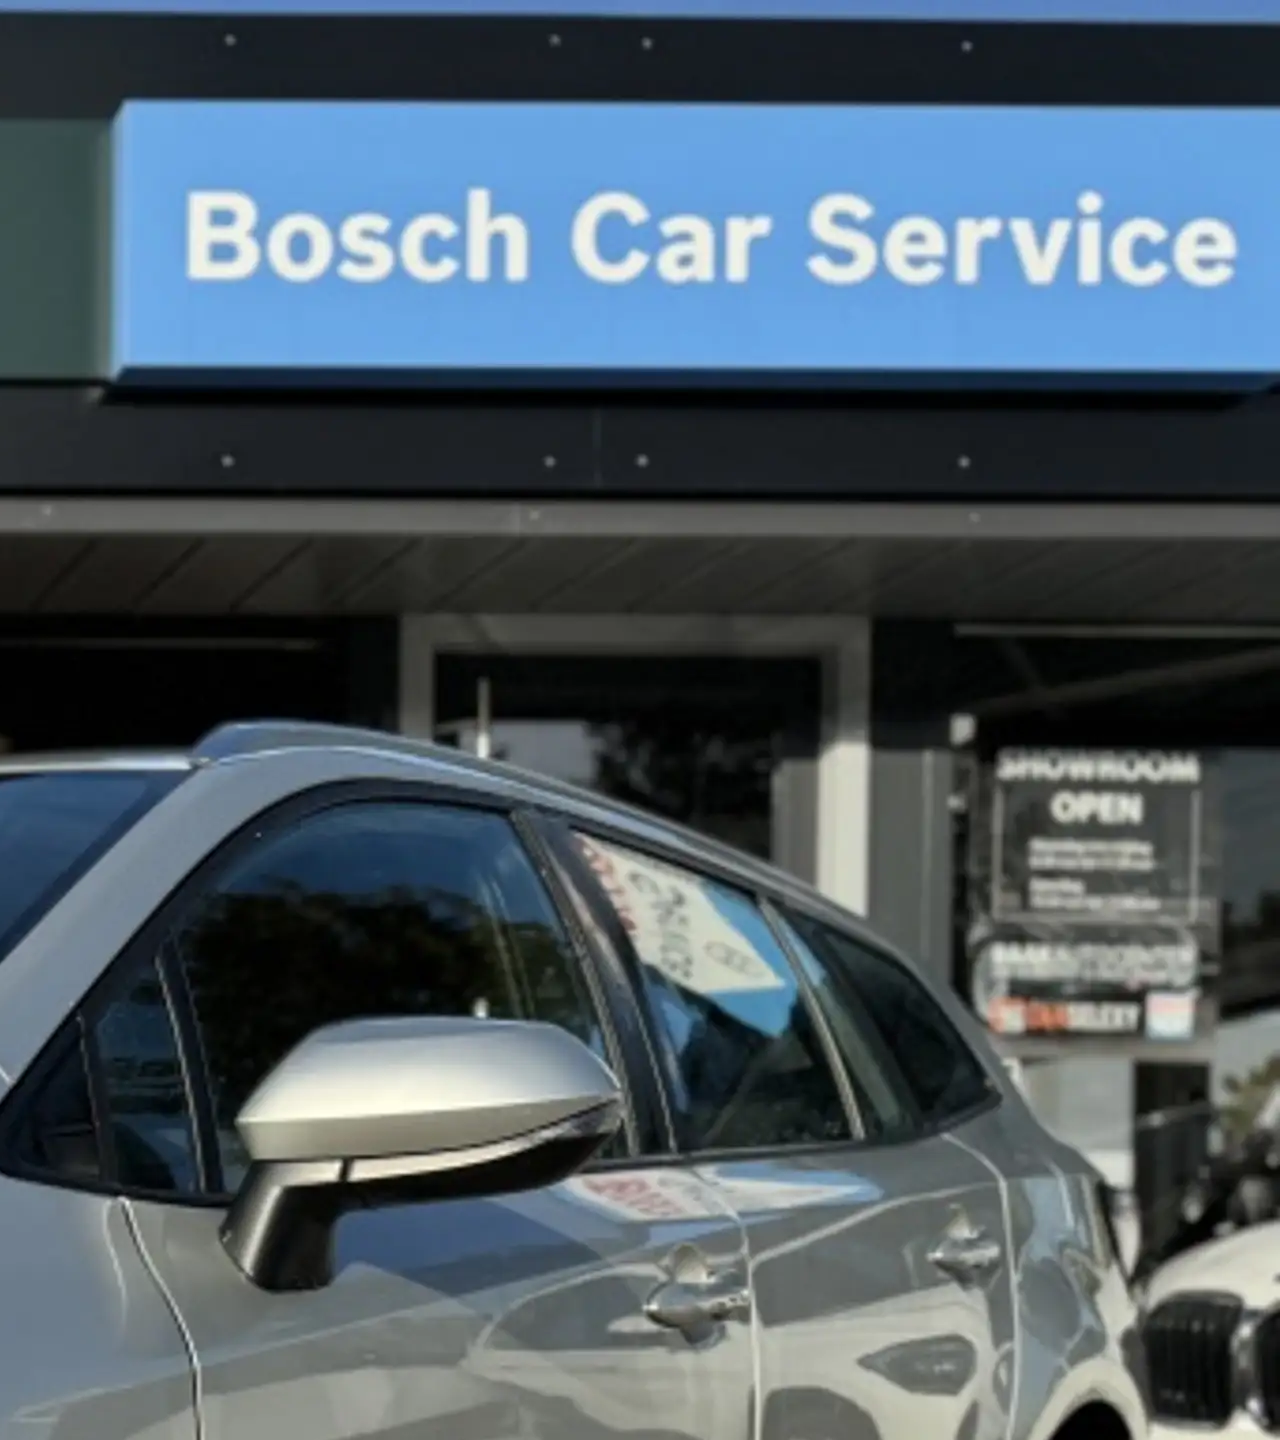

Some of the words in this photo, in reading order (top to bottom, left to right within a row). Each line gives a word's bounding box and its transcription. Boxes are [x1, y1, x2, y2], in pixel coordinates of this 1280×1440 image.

[189, 189, 527, 281] Bosch
[573, 193, 770, 282] Car
[809, 193, 1236, 285] Service
[1050, 791, 1144, 824] OPEN
